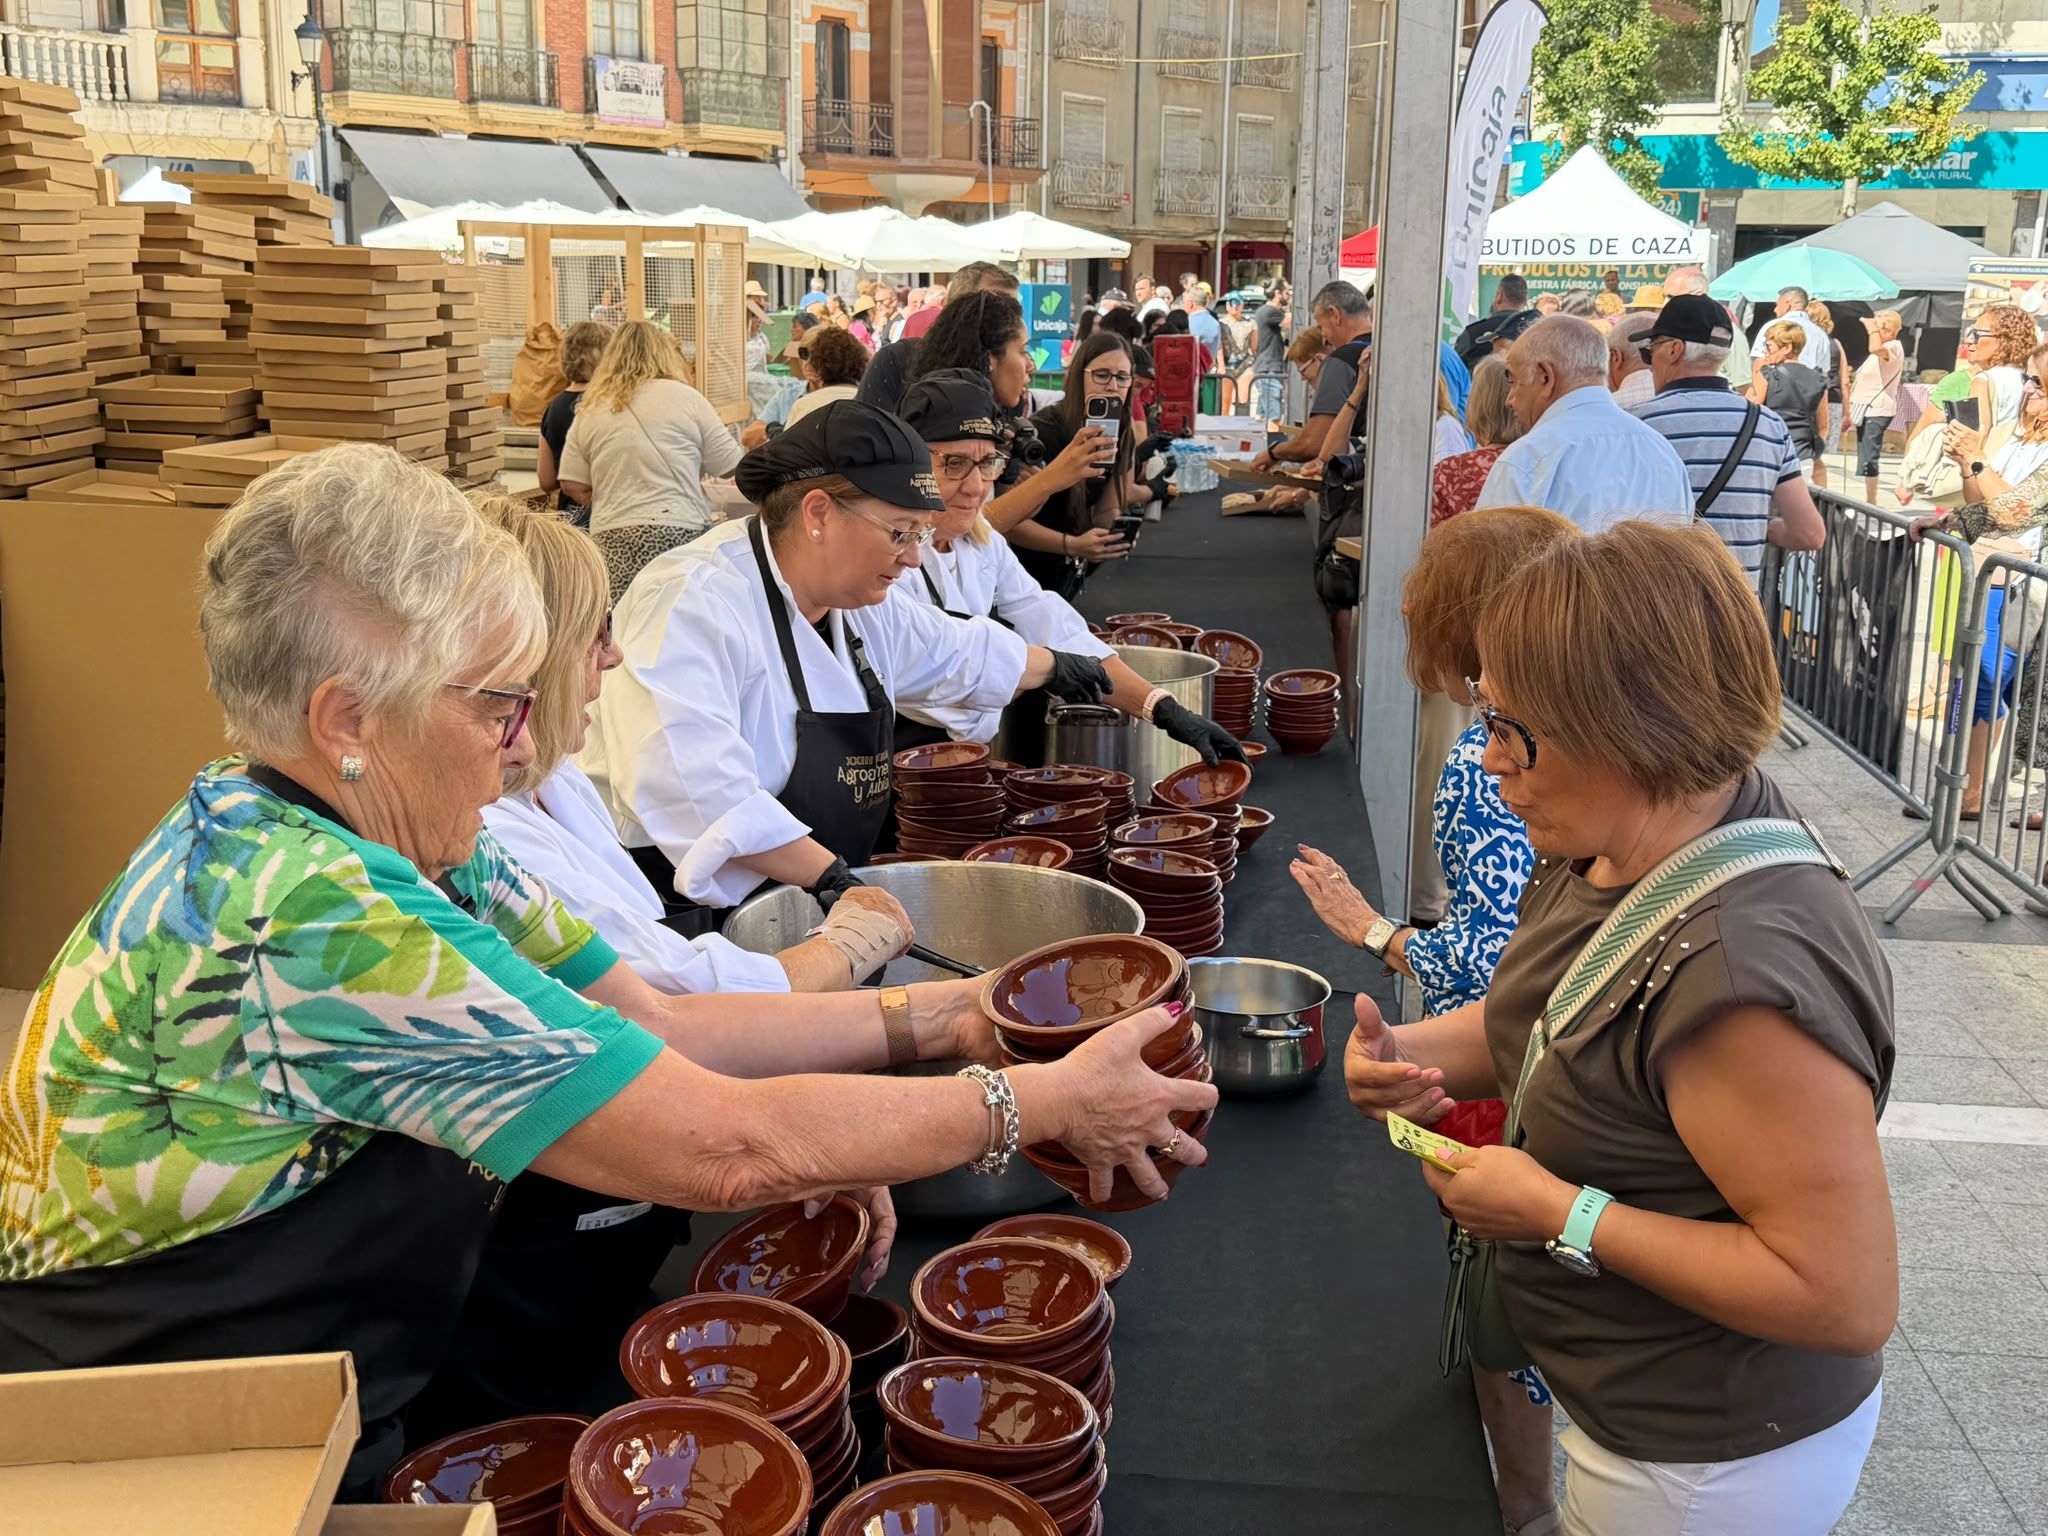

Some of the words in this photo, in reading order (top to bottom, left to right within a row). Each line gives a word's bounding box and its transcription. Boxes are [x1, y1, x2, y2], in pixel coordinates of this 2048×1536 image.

[1937, 170, 1973, 180] RURAL
[1589, 238, 1619, 255] DE
[1632, 237, 1692, 255] CAZA
[1625, 263, 1649, 278] LA
[1033, 319, 1067, 333] Unicaja
